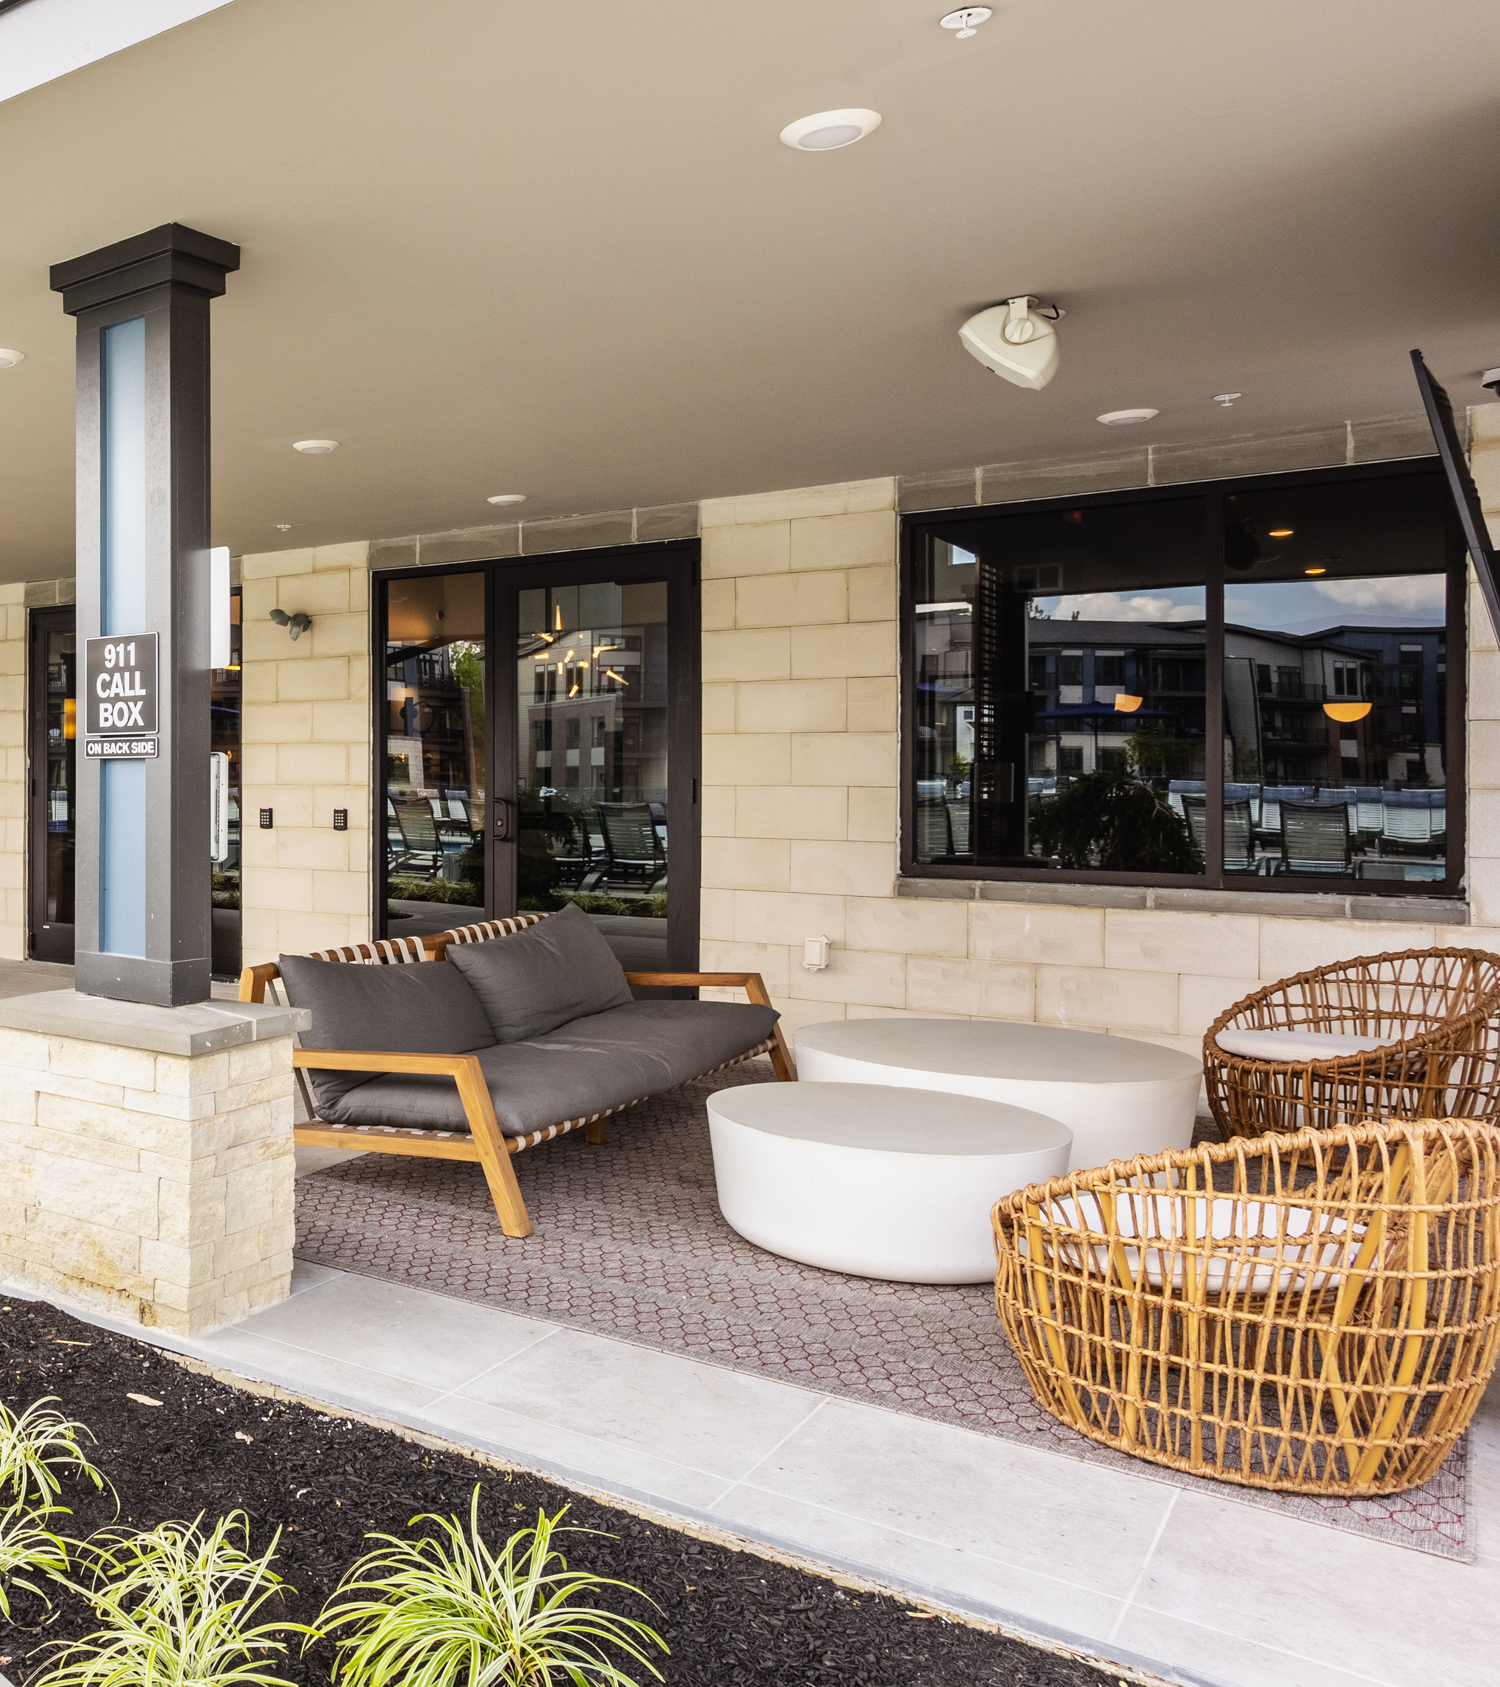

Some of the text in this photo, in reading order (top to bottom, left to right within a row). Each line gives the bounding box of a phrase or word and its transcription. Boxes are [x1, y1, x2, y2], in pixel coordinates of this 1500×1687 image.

[104, 642, 135, 668] 911
[96, 671, 146, 698] CALL
[99, 701, 145, 727] BOX
[87, 741, 155, 754] ON BACK SIDE
